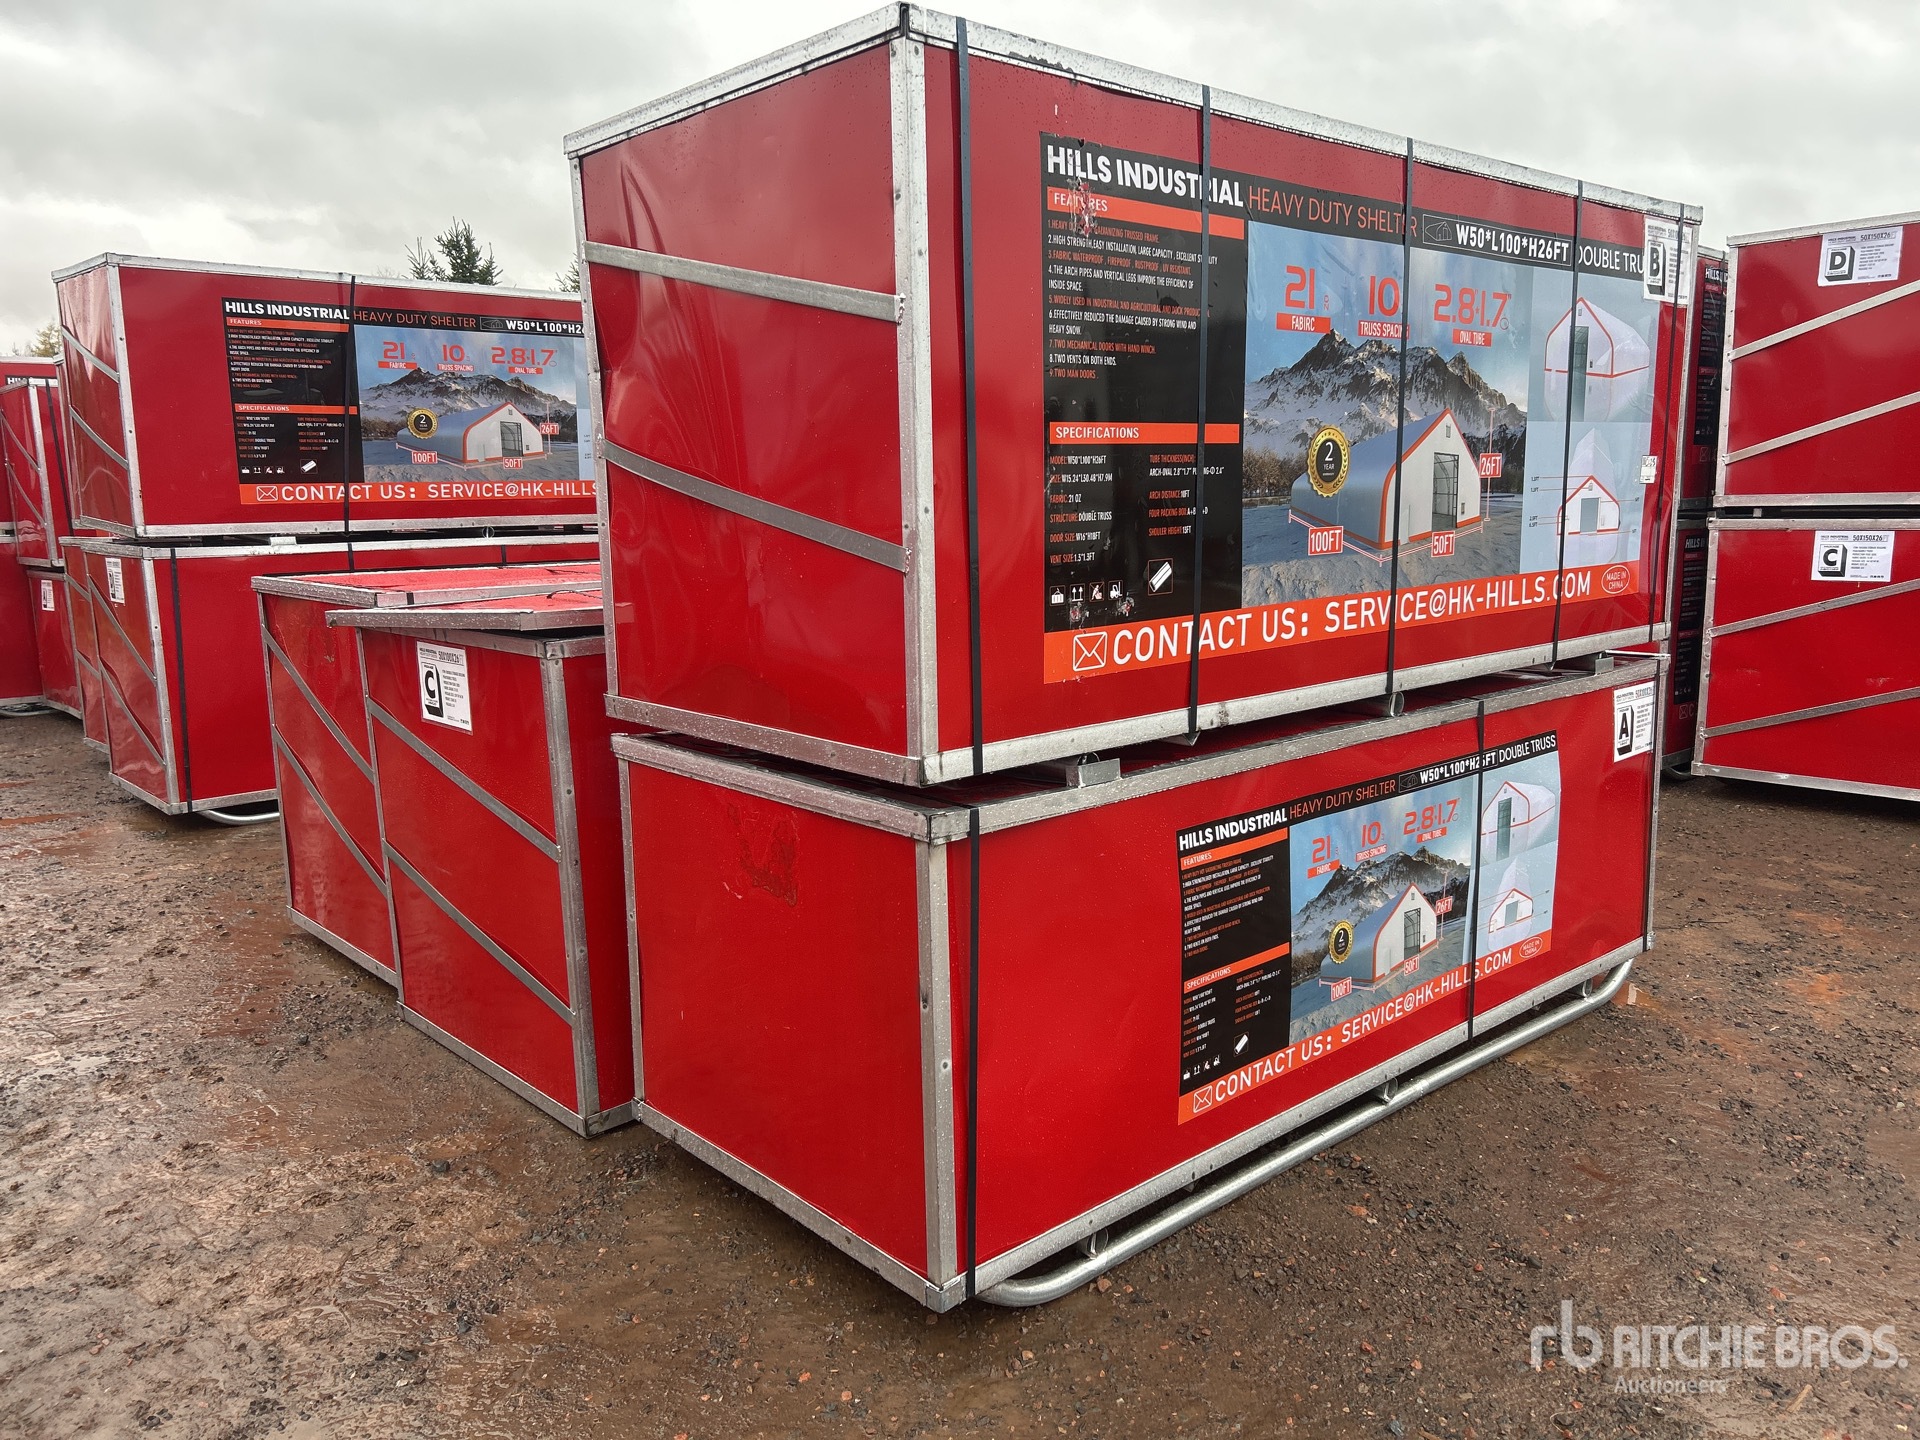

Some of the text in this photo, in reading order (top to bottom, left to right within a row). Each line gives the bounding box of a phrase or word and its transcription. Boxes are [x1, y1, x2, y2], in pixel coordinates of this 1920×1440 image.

[1047, 145, 1111, 183] HILLS
[1248, 186, 1304, 218] HEAVY
[1308, 198, 1353, 226] DUTY
[1649, 247, 1659, 277] B
[1829, 251, 1846, 270] D
[1064, 265, 1078, 276] ARCH
[1079, 267, 1092, 278] PIPES
[1093, 269, 1103, 279] AND
[1104, 270, 1125, 281] VERTICAL
[1705, 268, 1719, 280] HILLS
[1049, 279, 1083, 291] INSIDE SPACE.
[1285, 265, 1315, 309] 21
[1073, 297, 1085, 306] USED
[1087, 297, 1091, 306] IN
[1093, 298, 1119, 309] INDUSTRIAL
[1120, 301, 1129, 310] AND
[1369, 275, 1400, 316] 10
[225, 301, 476, 328] HILLS INDUSTRIAL HEAVY DUTY SHELTER
[1083, 311, 1105, 322] REDUCED
[1106, 313, 1115, 323] THE
[1115, 314, 1133, 325] DAMAGE
[1135, 316, 1151, 326] CAUSED
[1152, 318, 1158, 327] BY
[1159, 318, 1175, 328] STRONG
[1176, 320, 1187, 329] WIND
[1188, 321, 1196, 330] AND
[1291, 315, 1315, 331] FABIRC
[1049, 324, 1065, 334] HEAVY
[1360, 321, 1381, 337] TRUSS
[1460, 330, 1485, 345] OVAL TUBE
[383, 341, 405, 359] 21
[442, 344, 465, 362] 10
[1067, 340, 1097, 350] MECHANICAL
[1099, 342, 1114, 351] DOORS
[1115, 343, 1126, 352] WITH
[1128, 344, 1140, 353] HAND
[438, 363, 454, 371] TRUSS
[1067, 354, 1081, 364] VENTS
[1083, 355, 1089, 364] ON
[1091, 355, 1103, 365] BOTH
[1067, 369, 1079, 378] MAN
[420, 415, 426, 423] 2
[541, 424, 558, 434] 26FT
[1056, 427, 1139, 439] SPECIFICATIONS
[413, 453, 436, 463] 100FT
[1325, 442, 1333, 461] 2
[504, 458, 522, 468] 50FT
[1480, 456, 1501, 476] 26FT
[281, 485, 416, 501] CONTACT US:
[1097, 511, 1112, 521] TRUSS
[1310, 529, 1342, 552] 100FT
[1432, 533, 1454, 555] 50FT
[1685, 538, 1700, 549] HILLS
[1823, 549, 1838, 566] C
[1606, 571, 1626, 580] MADE IN
[1609, 581, 1624, 590] CHINA
[1113, 571, 1591, 665] CONTACT US: SERVICE@HK-HILLS.COM
[424, 670, 436, 699] C
[1619, 712, 1629, 740] A
[1499, 735, 1556, 763] DOUBLE TRUSS
[1179, 779, 1396, 851] HILLS INDUSTRIAL HEAVY DUTY SHELTER
[1361, 822, 1381, 847] 10
[1312, 835, 1331, 863] 21
[1184, 852, 1212, 866] FEATURES
[1436, 897, 1452, 914] 26FT
[1339, 930, 1344, 942] 2
[1404, 957, 1419, 974] 50FT
[1186, 967, 1231, 990] SPECIFICATIONS
[1332, 979, 1351, 1000] 100FT
[1215, 1047, 1296, 1102] CONTACT
[1301, 1035, 1332, 1061] US:
[1341, 948, 1512, 1045] SERVICE@HK-HILLS.COM
